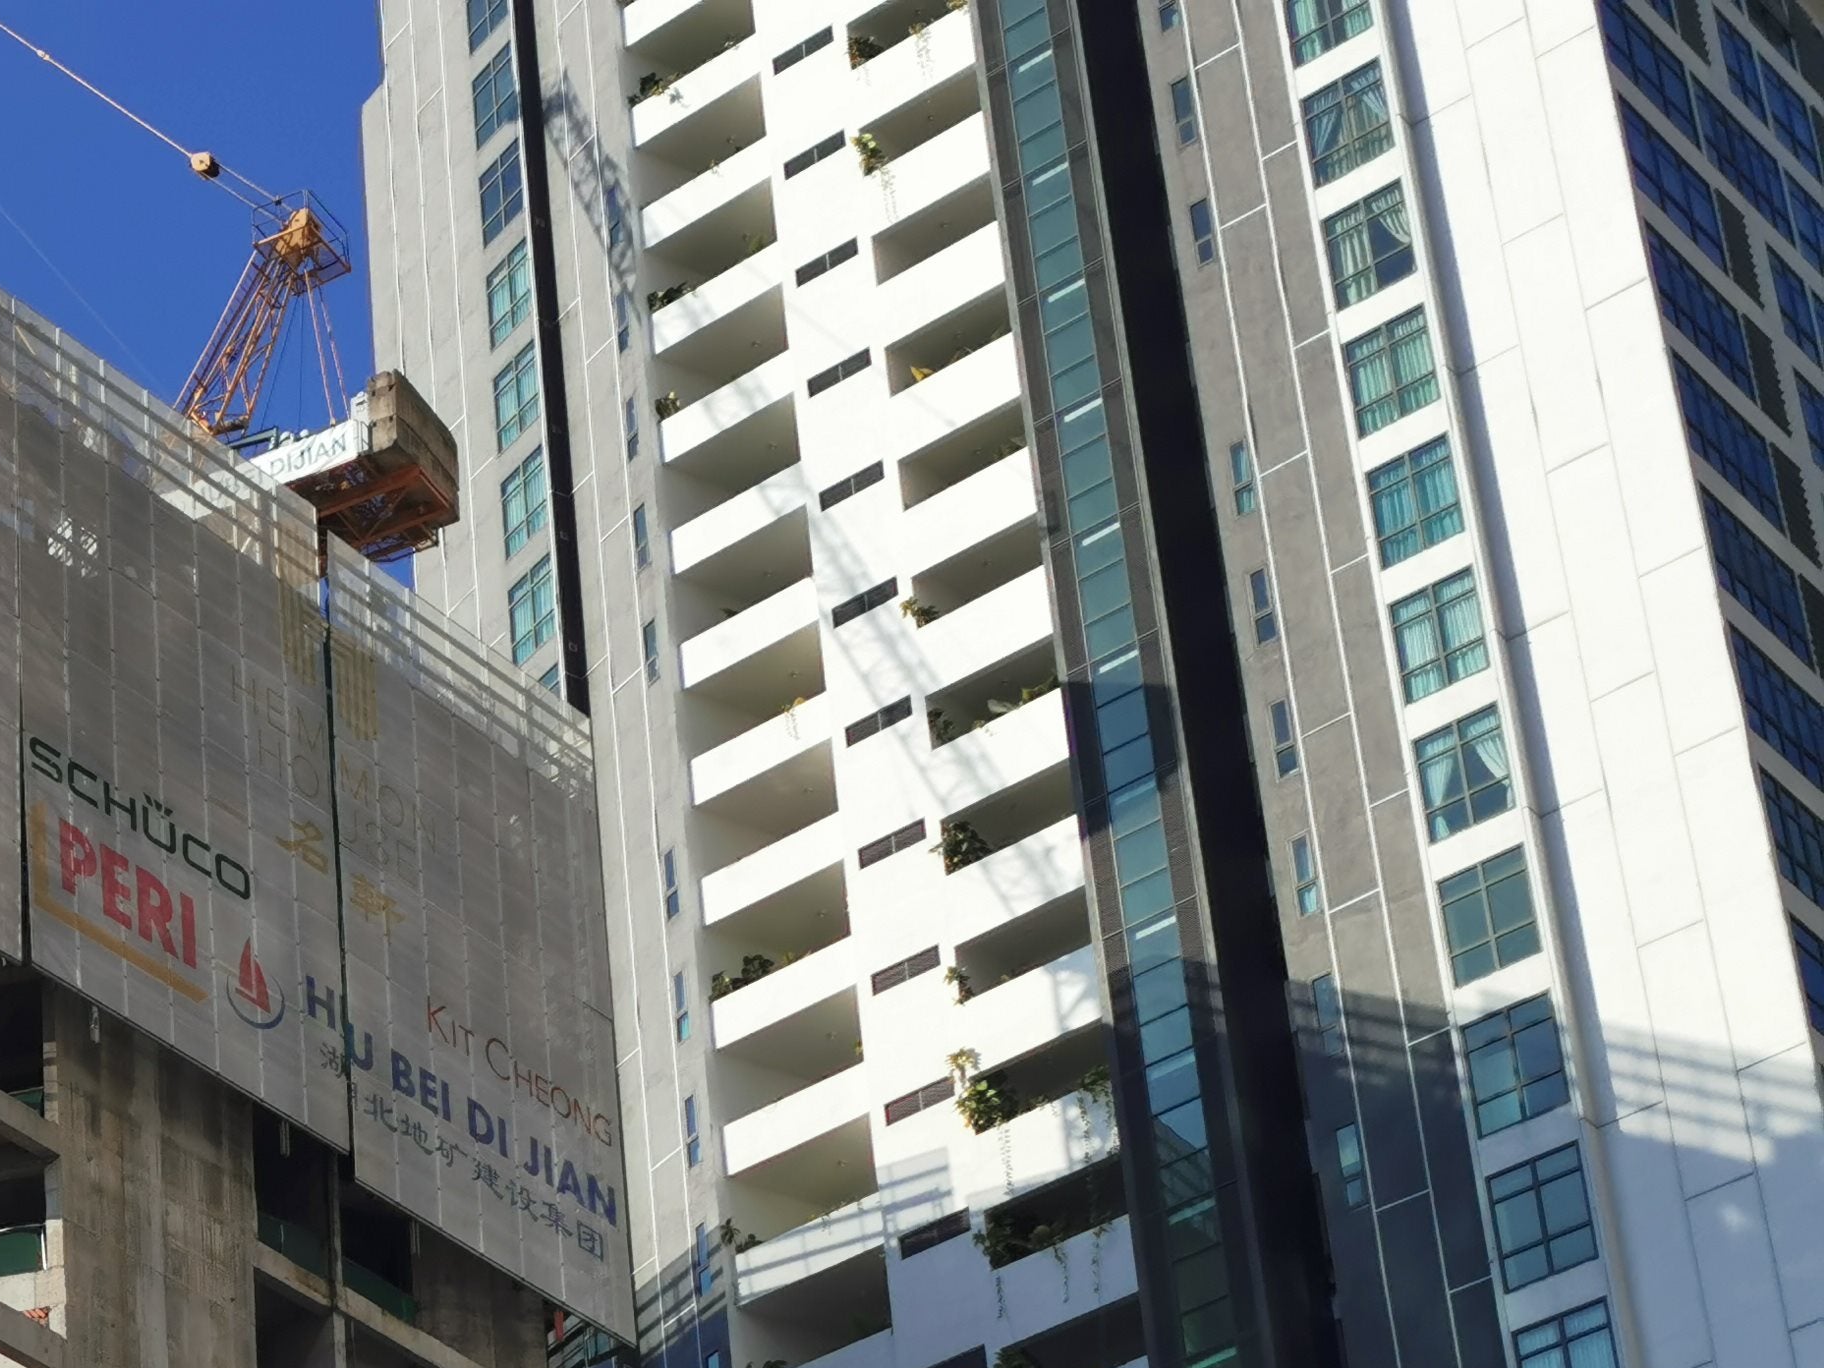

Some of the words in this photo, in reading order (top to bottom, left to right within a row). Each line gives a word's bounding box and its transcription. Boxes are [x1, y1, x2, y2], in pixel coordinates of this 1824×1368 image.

[29, 736, 251, 901] SCHÜCO
[58, 817, 198, 970] PERI
[305, 975, 374, 1071] HU
[391, 1048, 451, 1122] BEI
[468, 1096, 508, 1159] DI
[523, 1138, 617, 1228] JIAN
[427, 996, 475, 1059] KIT
